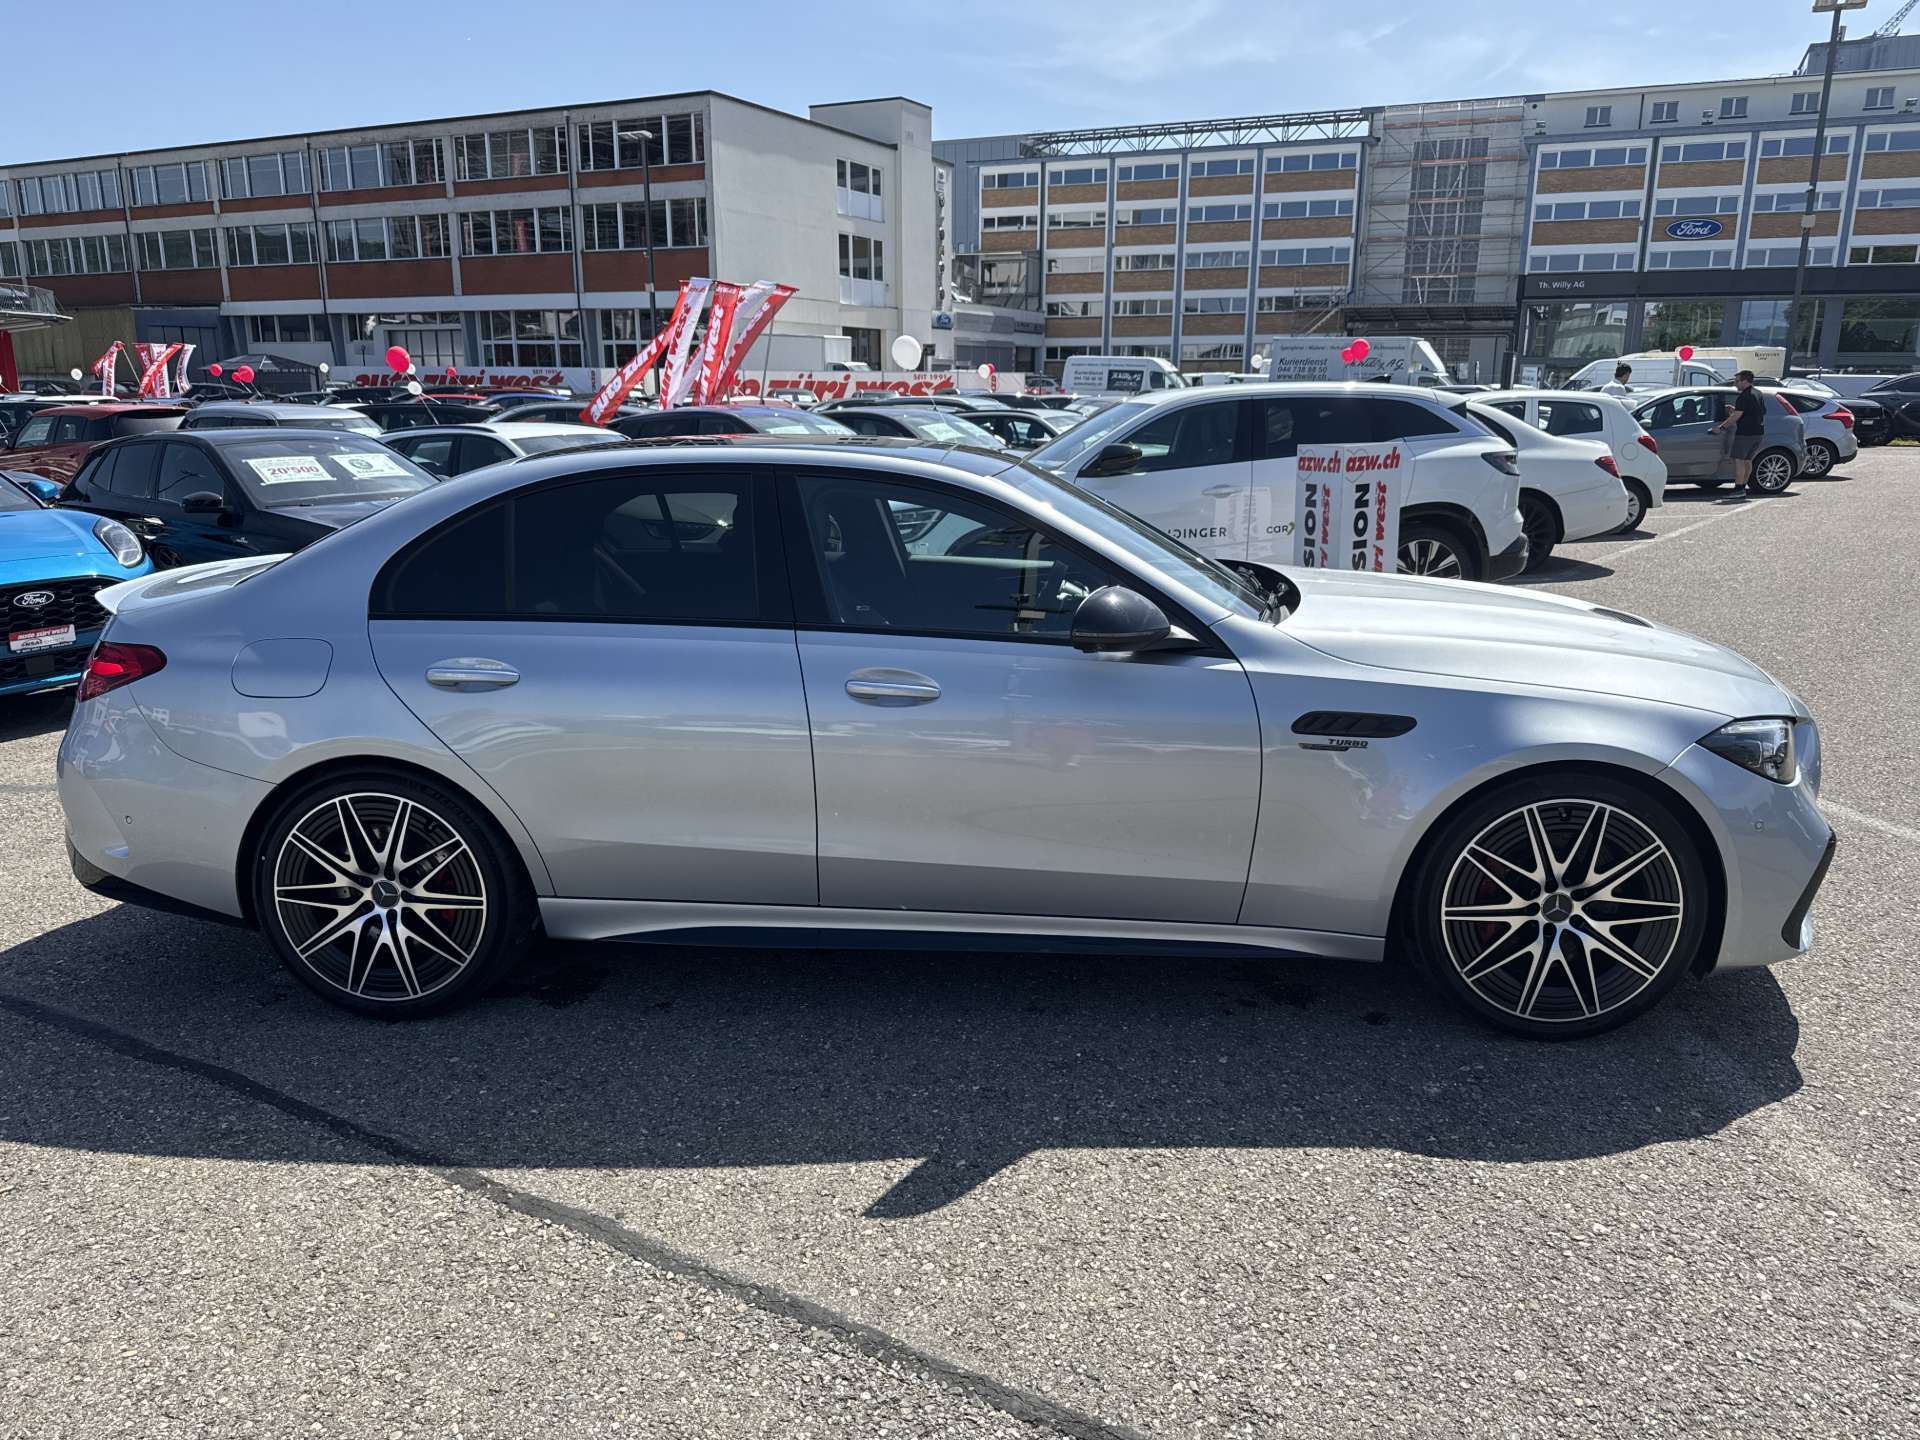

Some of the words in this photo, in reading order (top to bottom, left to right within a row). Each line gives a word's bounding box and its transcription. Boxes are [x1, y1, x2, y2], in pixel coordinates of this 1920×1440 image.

[1539, 281, 1550, 289] Th.
[1552, 281, 1572, 290] Willy
[1573, 280, 1585, 289] AG
[704, 304, 724, 361] west
[1279, 357, 1328, 367] Kurierdienst
[913, 373, 927, 381] SEIT
[590, 375, 622, 424] auto
[1298, 449, 1341, 473] azw.ch
[1345, 446, 1401, 473] azw.ch
[267, 465, 320, 476] 20'500
[1321, 483, 1331, 545] west
[1375, 480, 1387, 541] west
[1168, 526, 1227, 538] DINGER
[1328, 738, 1368, 748] TURBO
